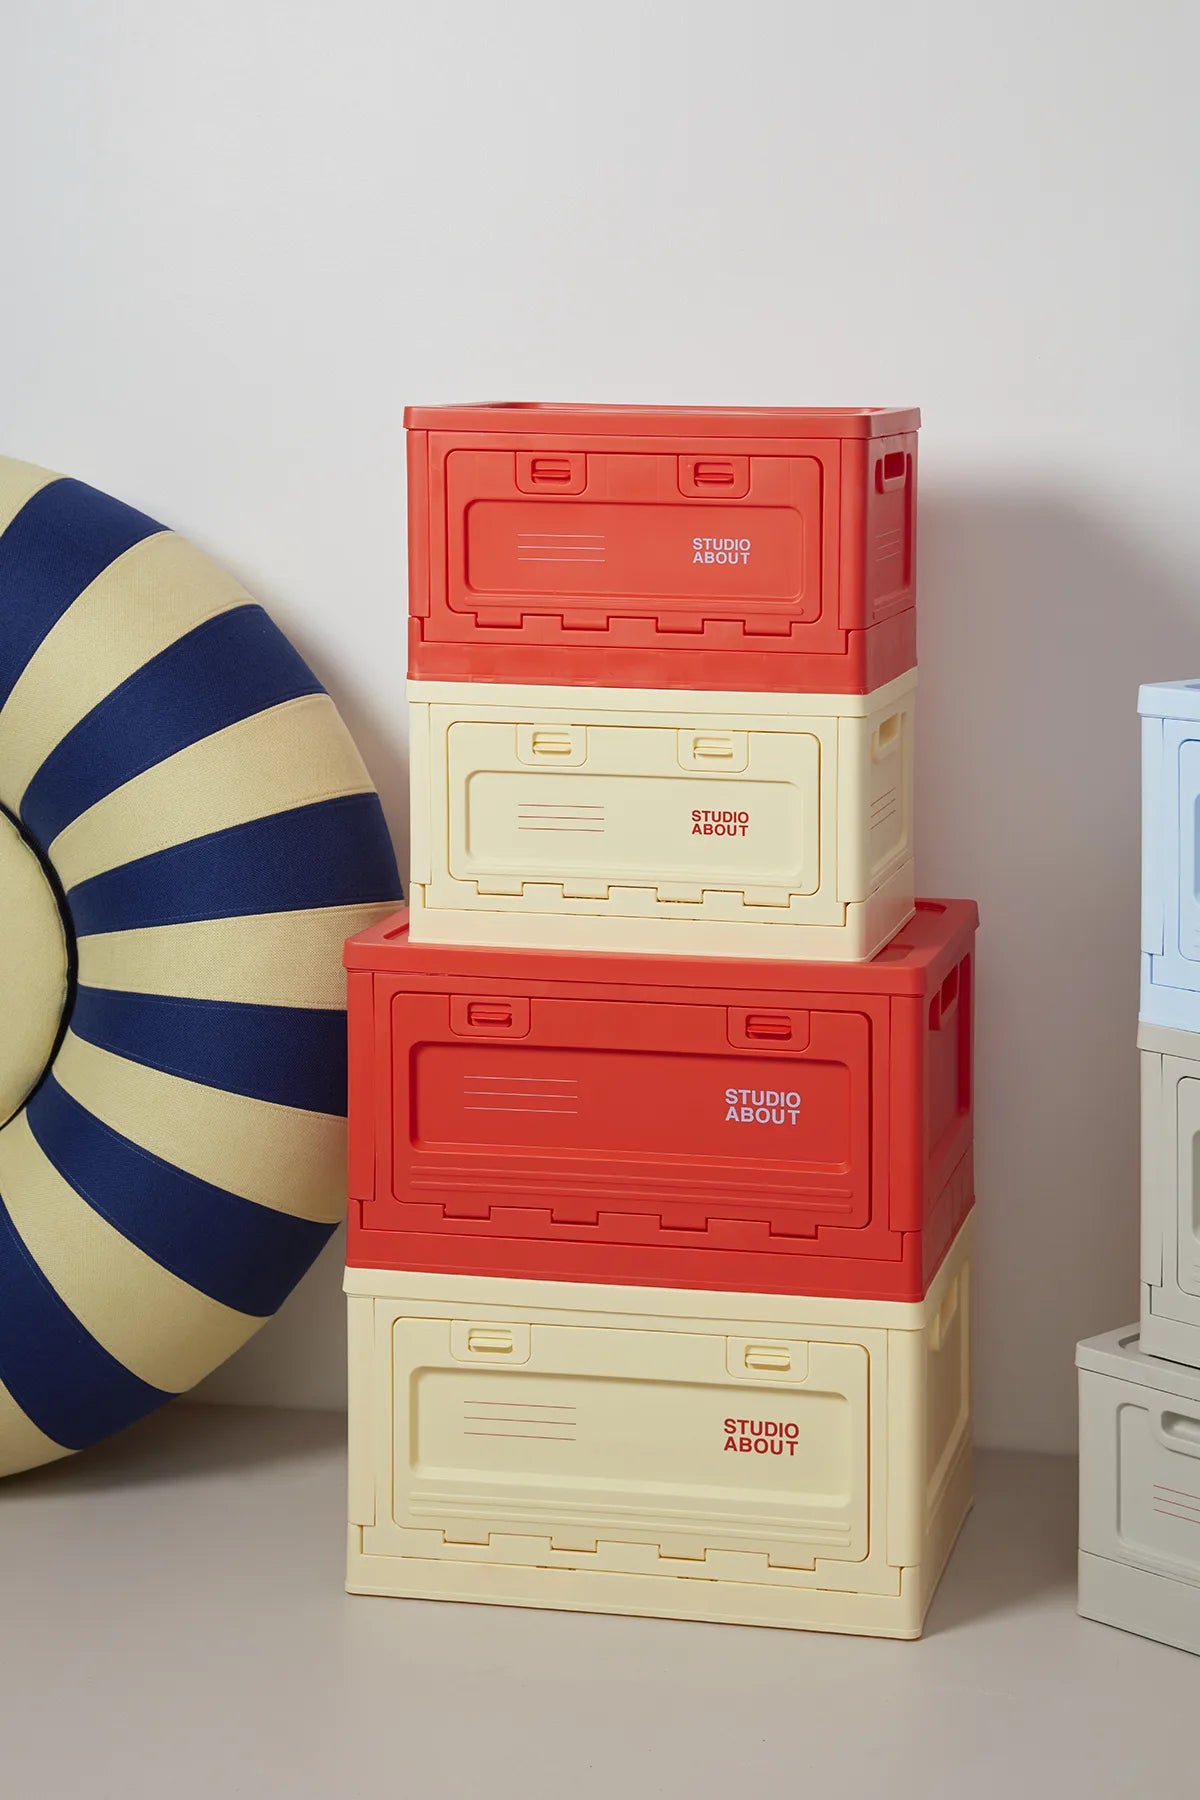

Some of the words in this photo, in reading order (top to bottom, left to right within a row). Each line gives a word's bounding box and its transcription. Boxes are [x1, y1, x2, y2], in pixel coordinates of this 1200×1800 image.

[693, 538, 751, 551] STUDIO
[693, 551, 750, 564] ABOUT
[692, 810, 749, 824] STUDIO
[692, 823, 749, 836] ABOUT
[725, 1088, 801, 1108] STUDIO
[725, 1106, 800, 1125] ABOUT
[724, 1418, 799, 1439] STUDIO
[724, 1436, 798, 1456] ABOUT
